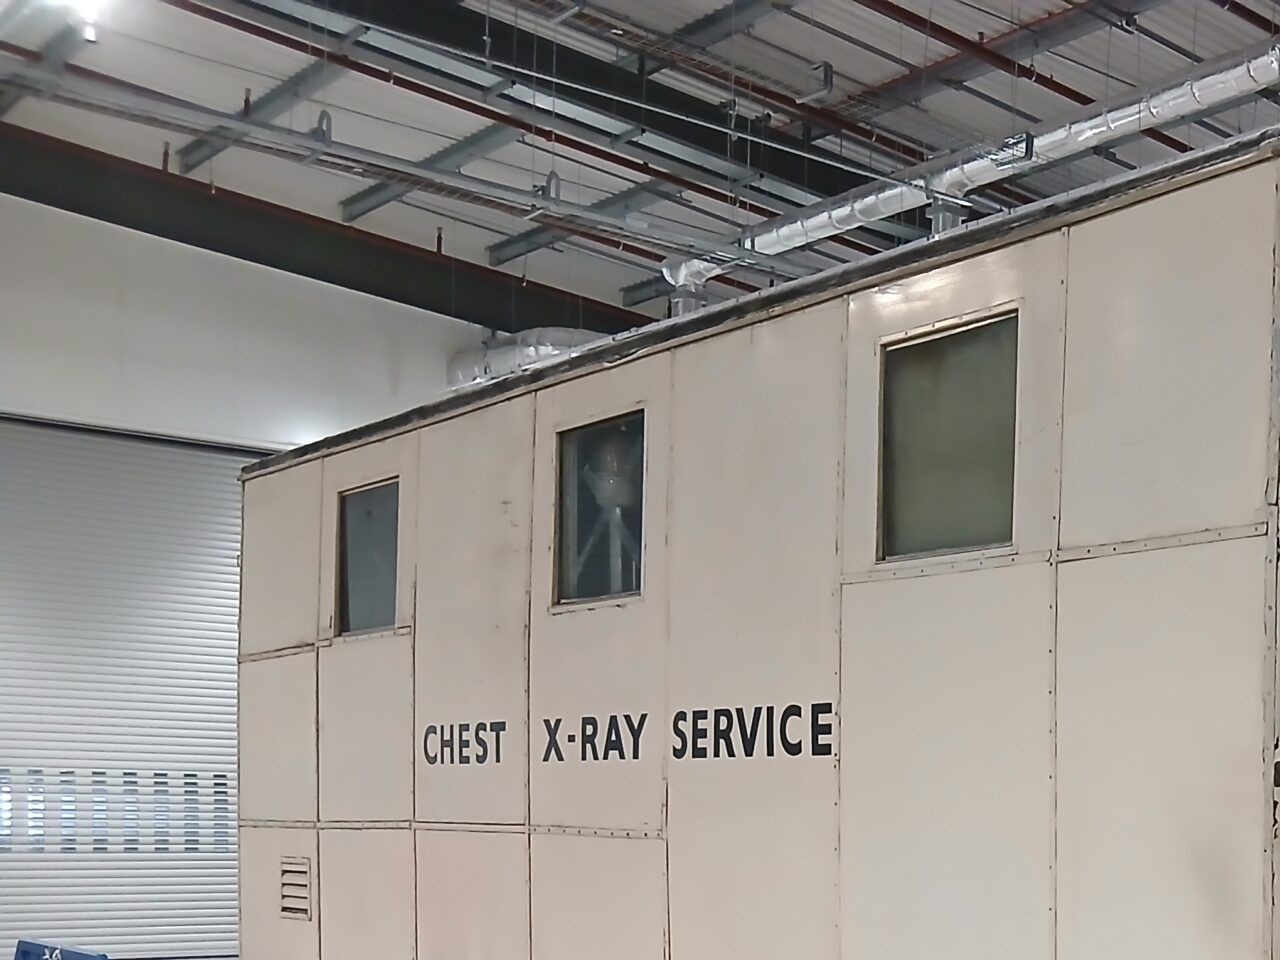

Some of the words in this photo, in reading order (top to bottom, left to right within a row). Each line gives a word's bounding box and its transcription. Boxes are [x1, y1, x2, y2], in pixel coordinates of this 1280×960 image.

[423, 722, 507, 765] CHEST
[542, 713, 648, 762] X-RAY
[672, 702, 833, 760] SERVICE
